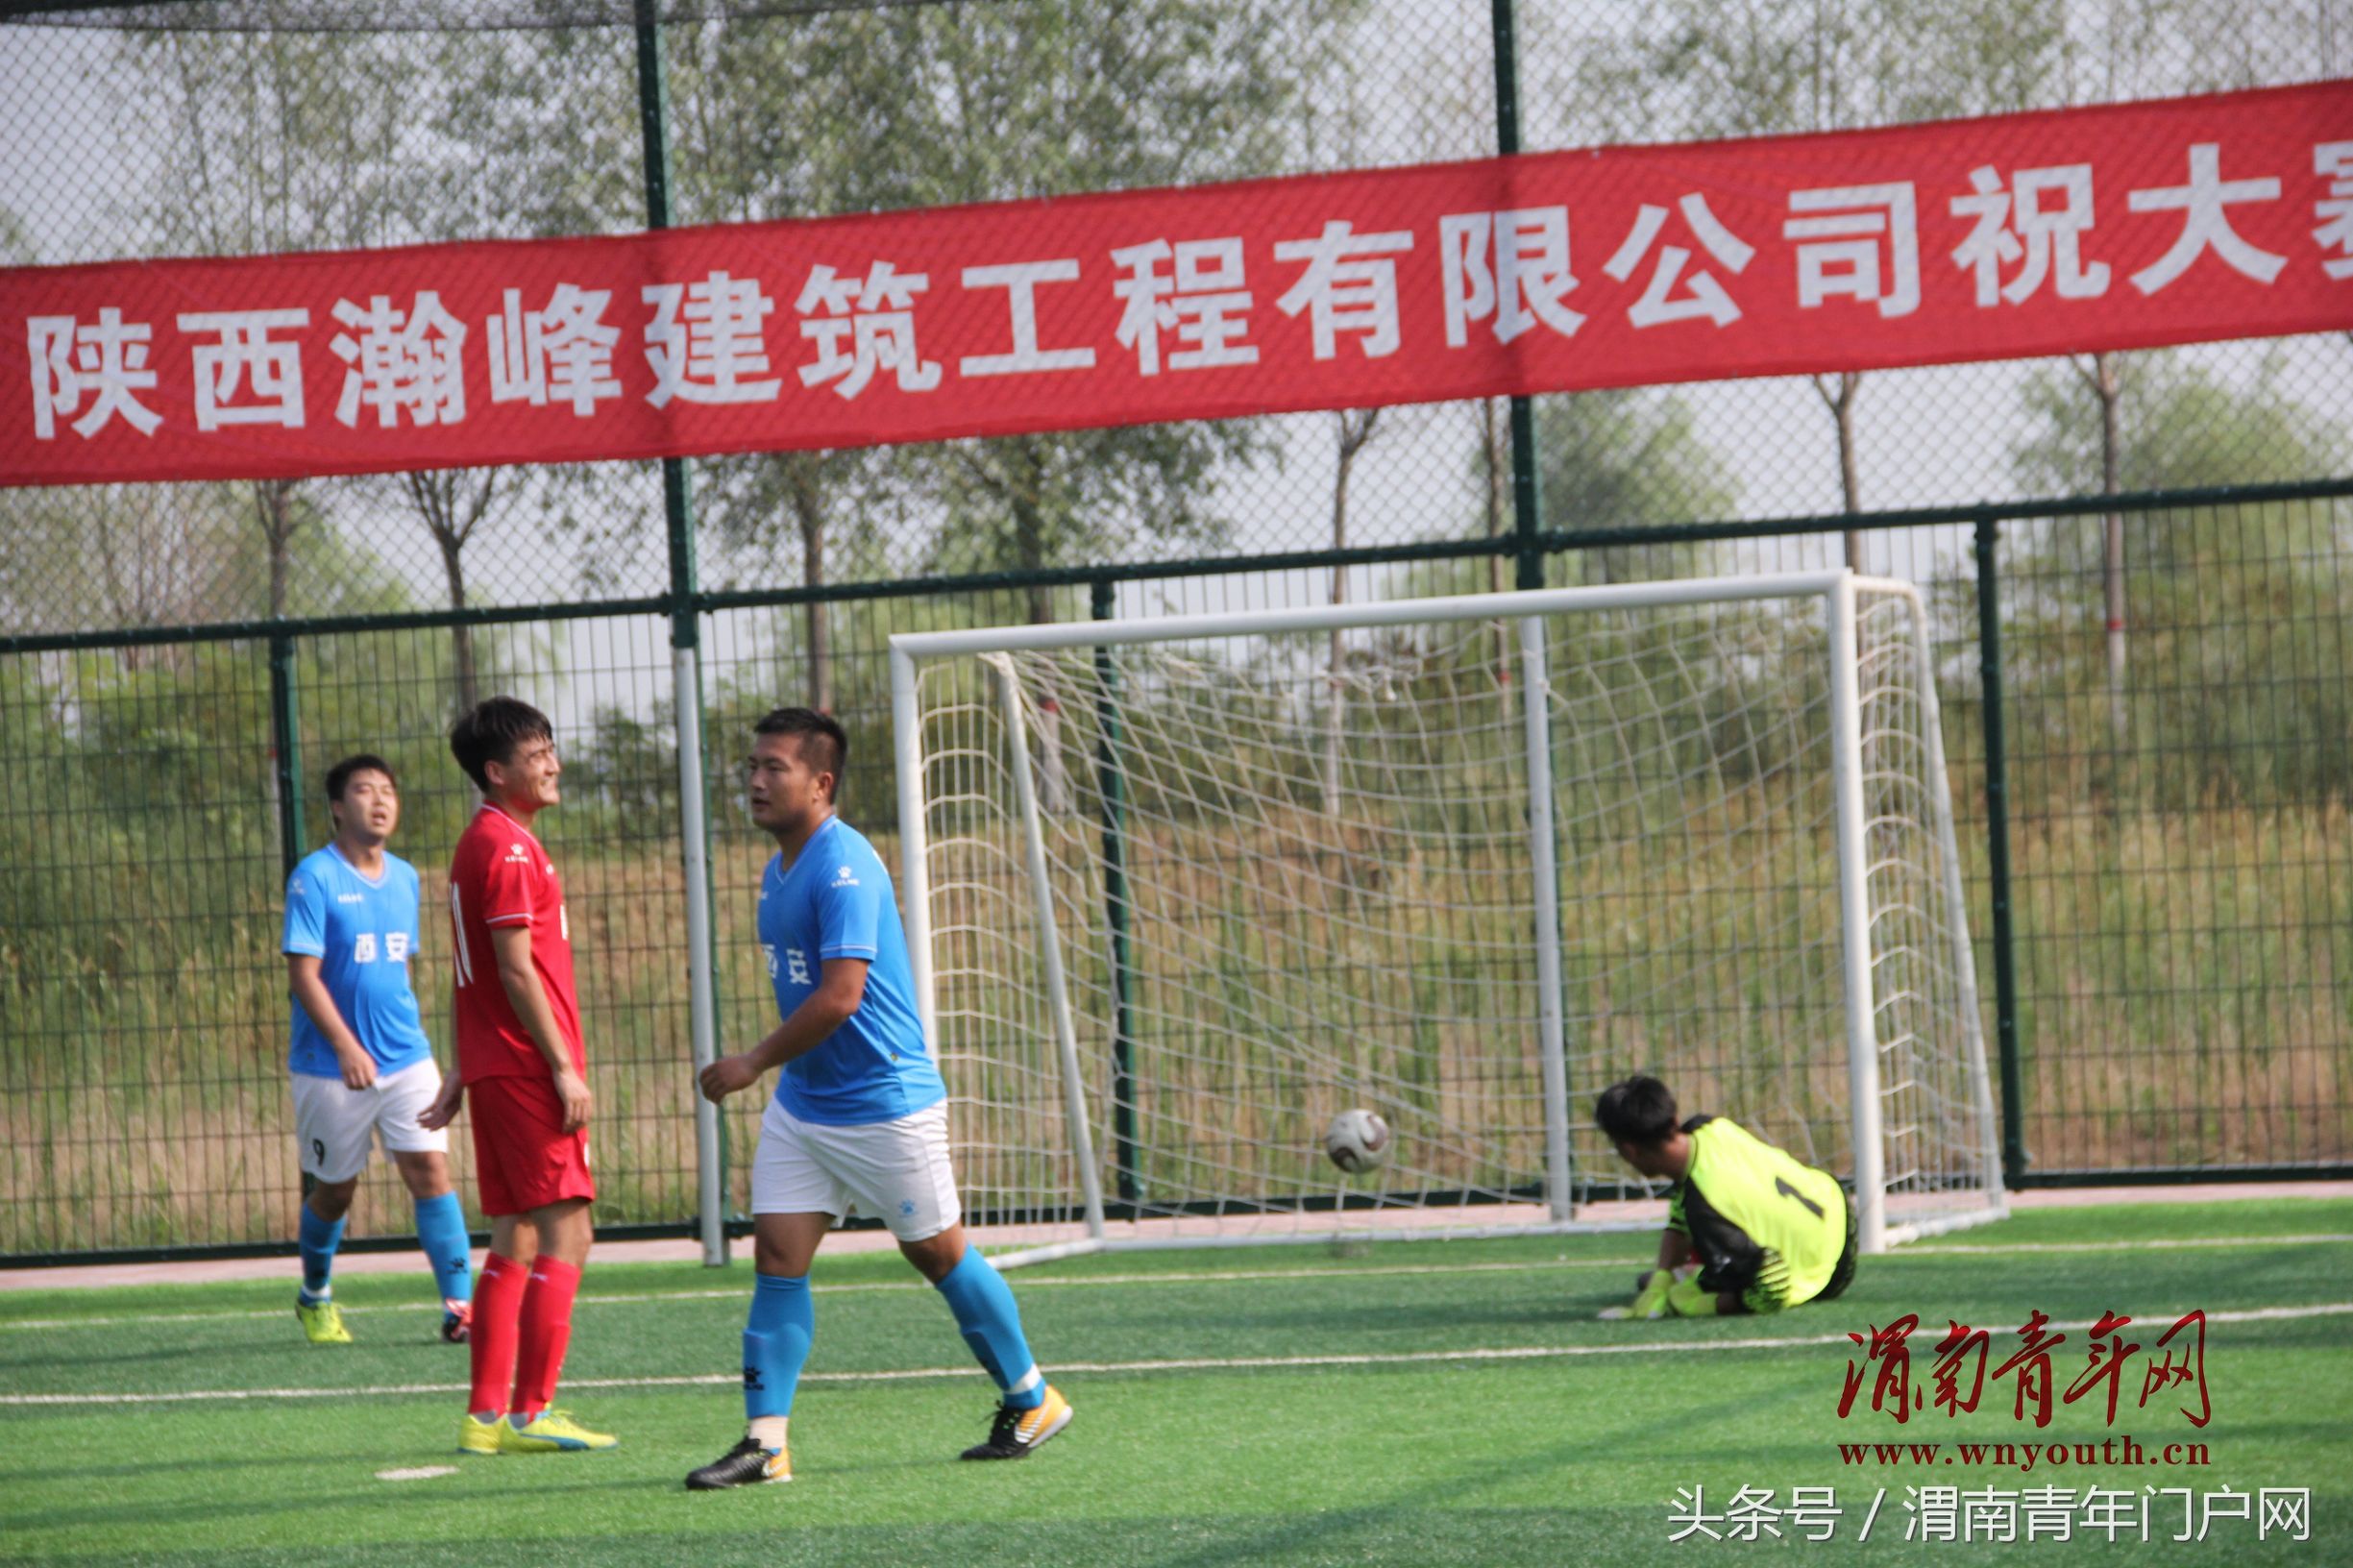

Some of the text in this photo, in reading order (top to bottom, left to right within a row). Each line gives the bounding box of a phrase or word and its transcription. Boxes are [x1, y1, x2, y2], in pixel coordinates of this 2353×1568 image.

[27, 141, 2353, 440] 陕西瀚峰建筑工程有限公司祝大
[312, 1138, 326, 1167] 9
[1775, 1175, 1825, 1220] 1
